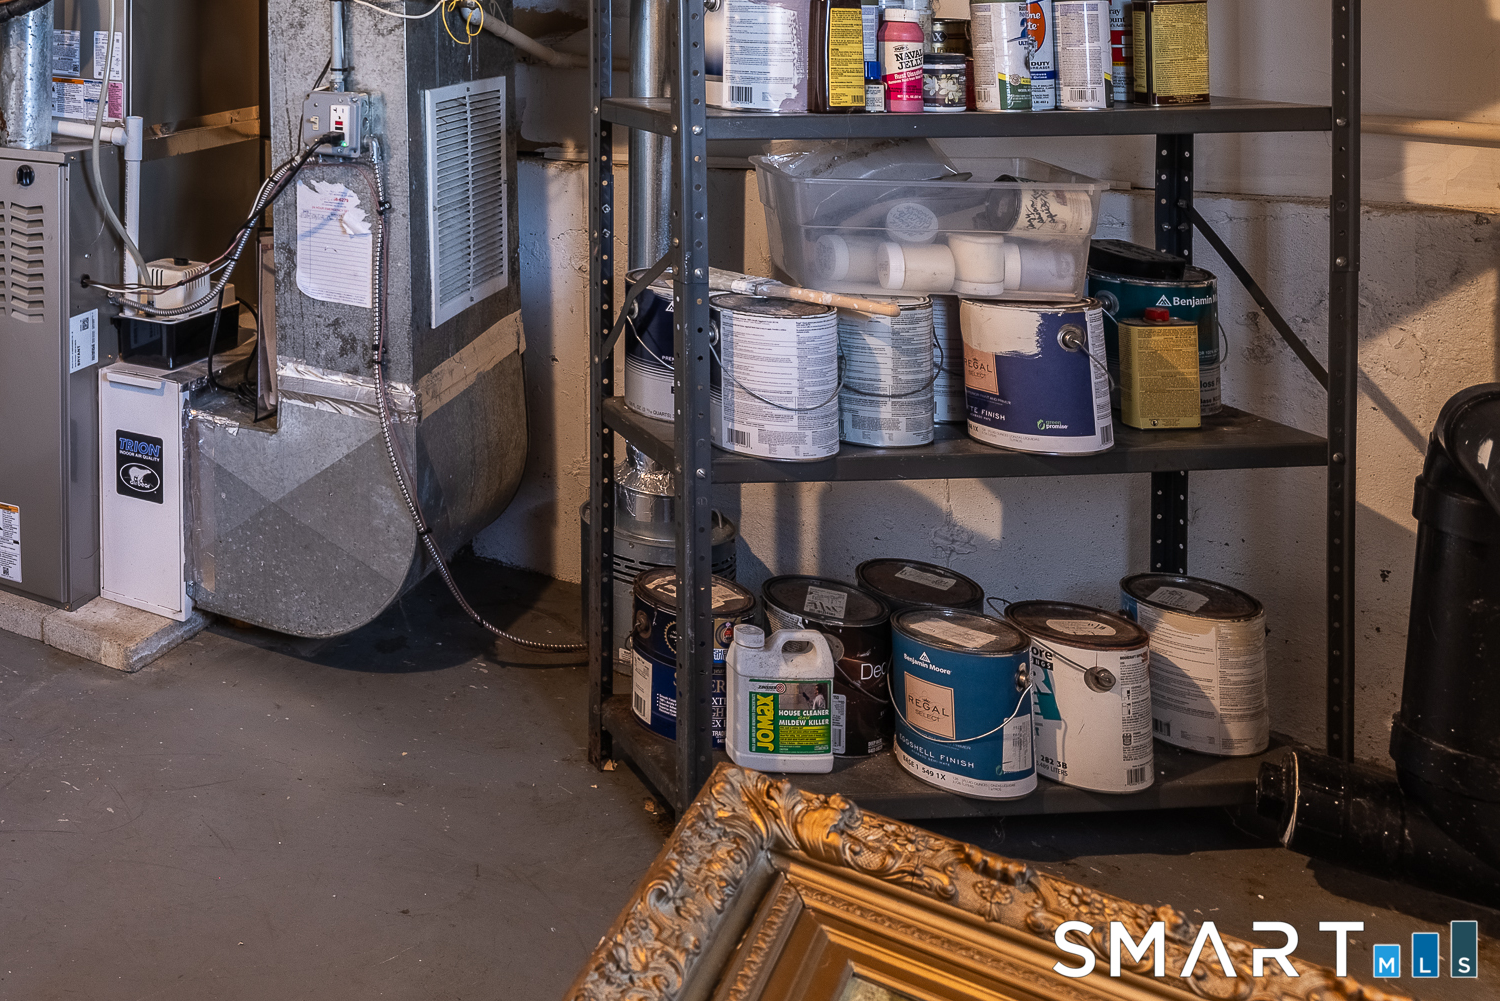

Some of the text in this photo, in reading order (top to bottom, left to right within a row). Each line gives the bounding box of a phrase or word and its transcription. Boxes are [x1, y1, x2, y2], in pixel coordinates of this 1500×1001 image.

[894, 48, 922, 62] NAVAL
[898, 57, 922, 70] JELLY
[1172, 296, 1212, 308] Benjamin
[1200, 380, 1215, 388] loss
[981, 409, 1006, 421] FINISH
[119, 437, 160, 458] TRION
[142, 454, 160, 462] QUALITY
[1031, 646, 1052, 660] ore
[860, 662, 887, 680] Dec
[904, 653, 952, 675] Benjamin Moore
[908, 694, 950, 718] REGAL
[808, 718, 830, 726] KILLER
[914, 709, 940, 722] SELECT
[899, 733, 975, 768] EGGSHELL FINISH
[902, 754, 914, 768] BASE
[922, 768, 934, 778] 549
[936, 772, 946, 780] 1X
[1040, 754, 1068, 770] 282 3B
[1051, 767, 1068, 776] LITERS
